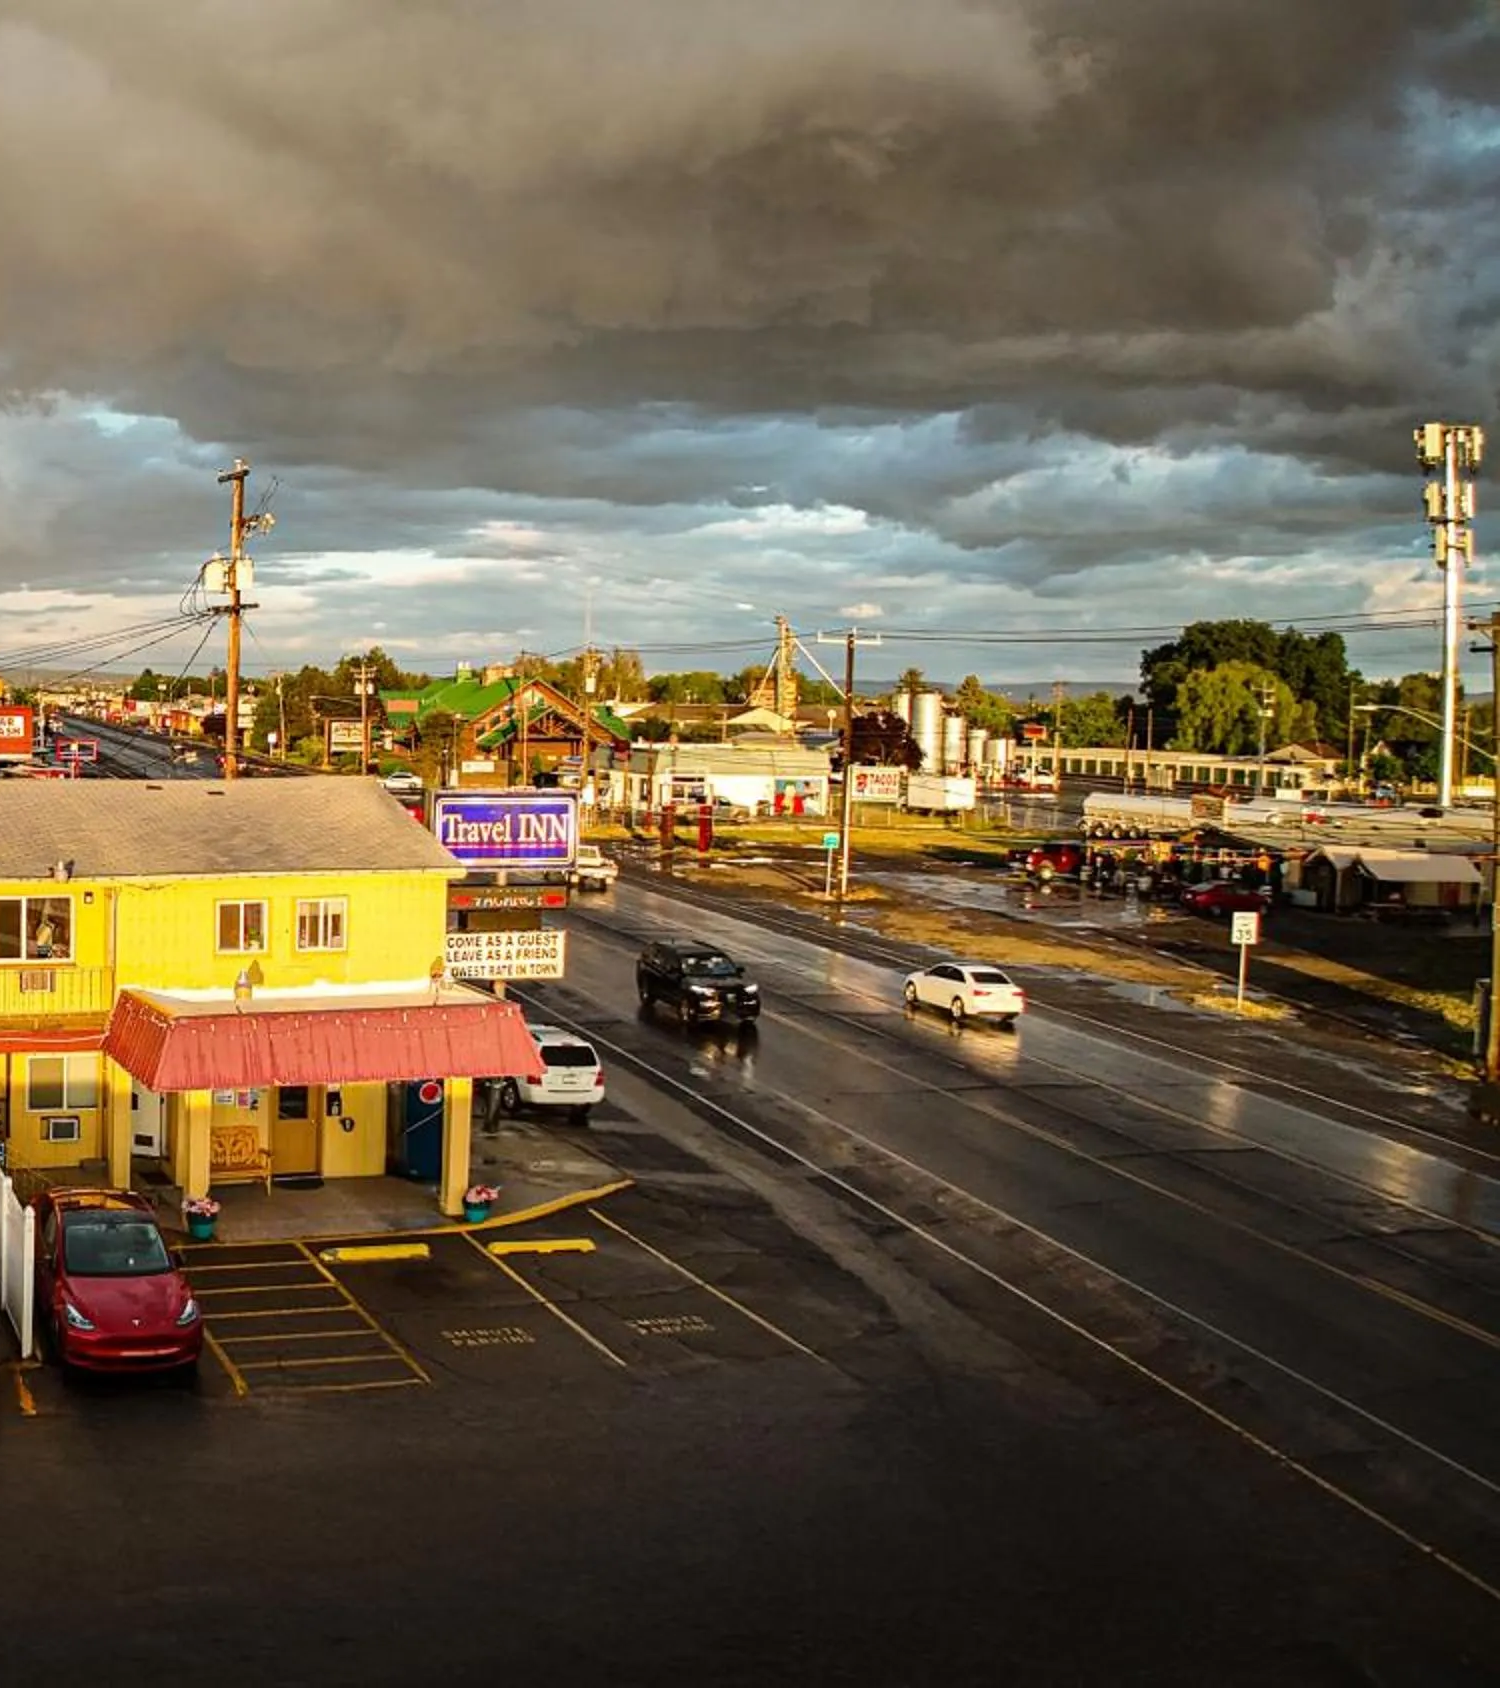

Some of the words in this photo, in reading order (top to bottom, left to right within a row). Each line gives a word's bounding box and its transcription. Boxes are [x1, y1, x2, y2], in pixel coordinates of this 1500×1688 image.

[442, 813, 512, 843] Travel
[517, 813, 569, 843] INN
[447, 936, 483, 949] COME
[486, 935, 502, 947] AS
[506, 935, 514, 946] A
[517, 932, 559, 946] GUEST
[1235, 929, 1253, 941] 35
[446, 950, 483, 963] LEAVE
[486, 949, 502, 961] AS
[505, 949, 513, 960] A
[516, 947, 557, 960] FRIEND
[450, 965, 486, 977] OWEST
[489, 964, 513, 976] RATE
[515, 963, 527, 975] IN
[530, 962, 558, 975] TOWN
